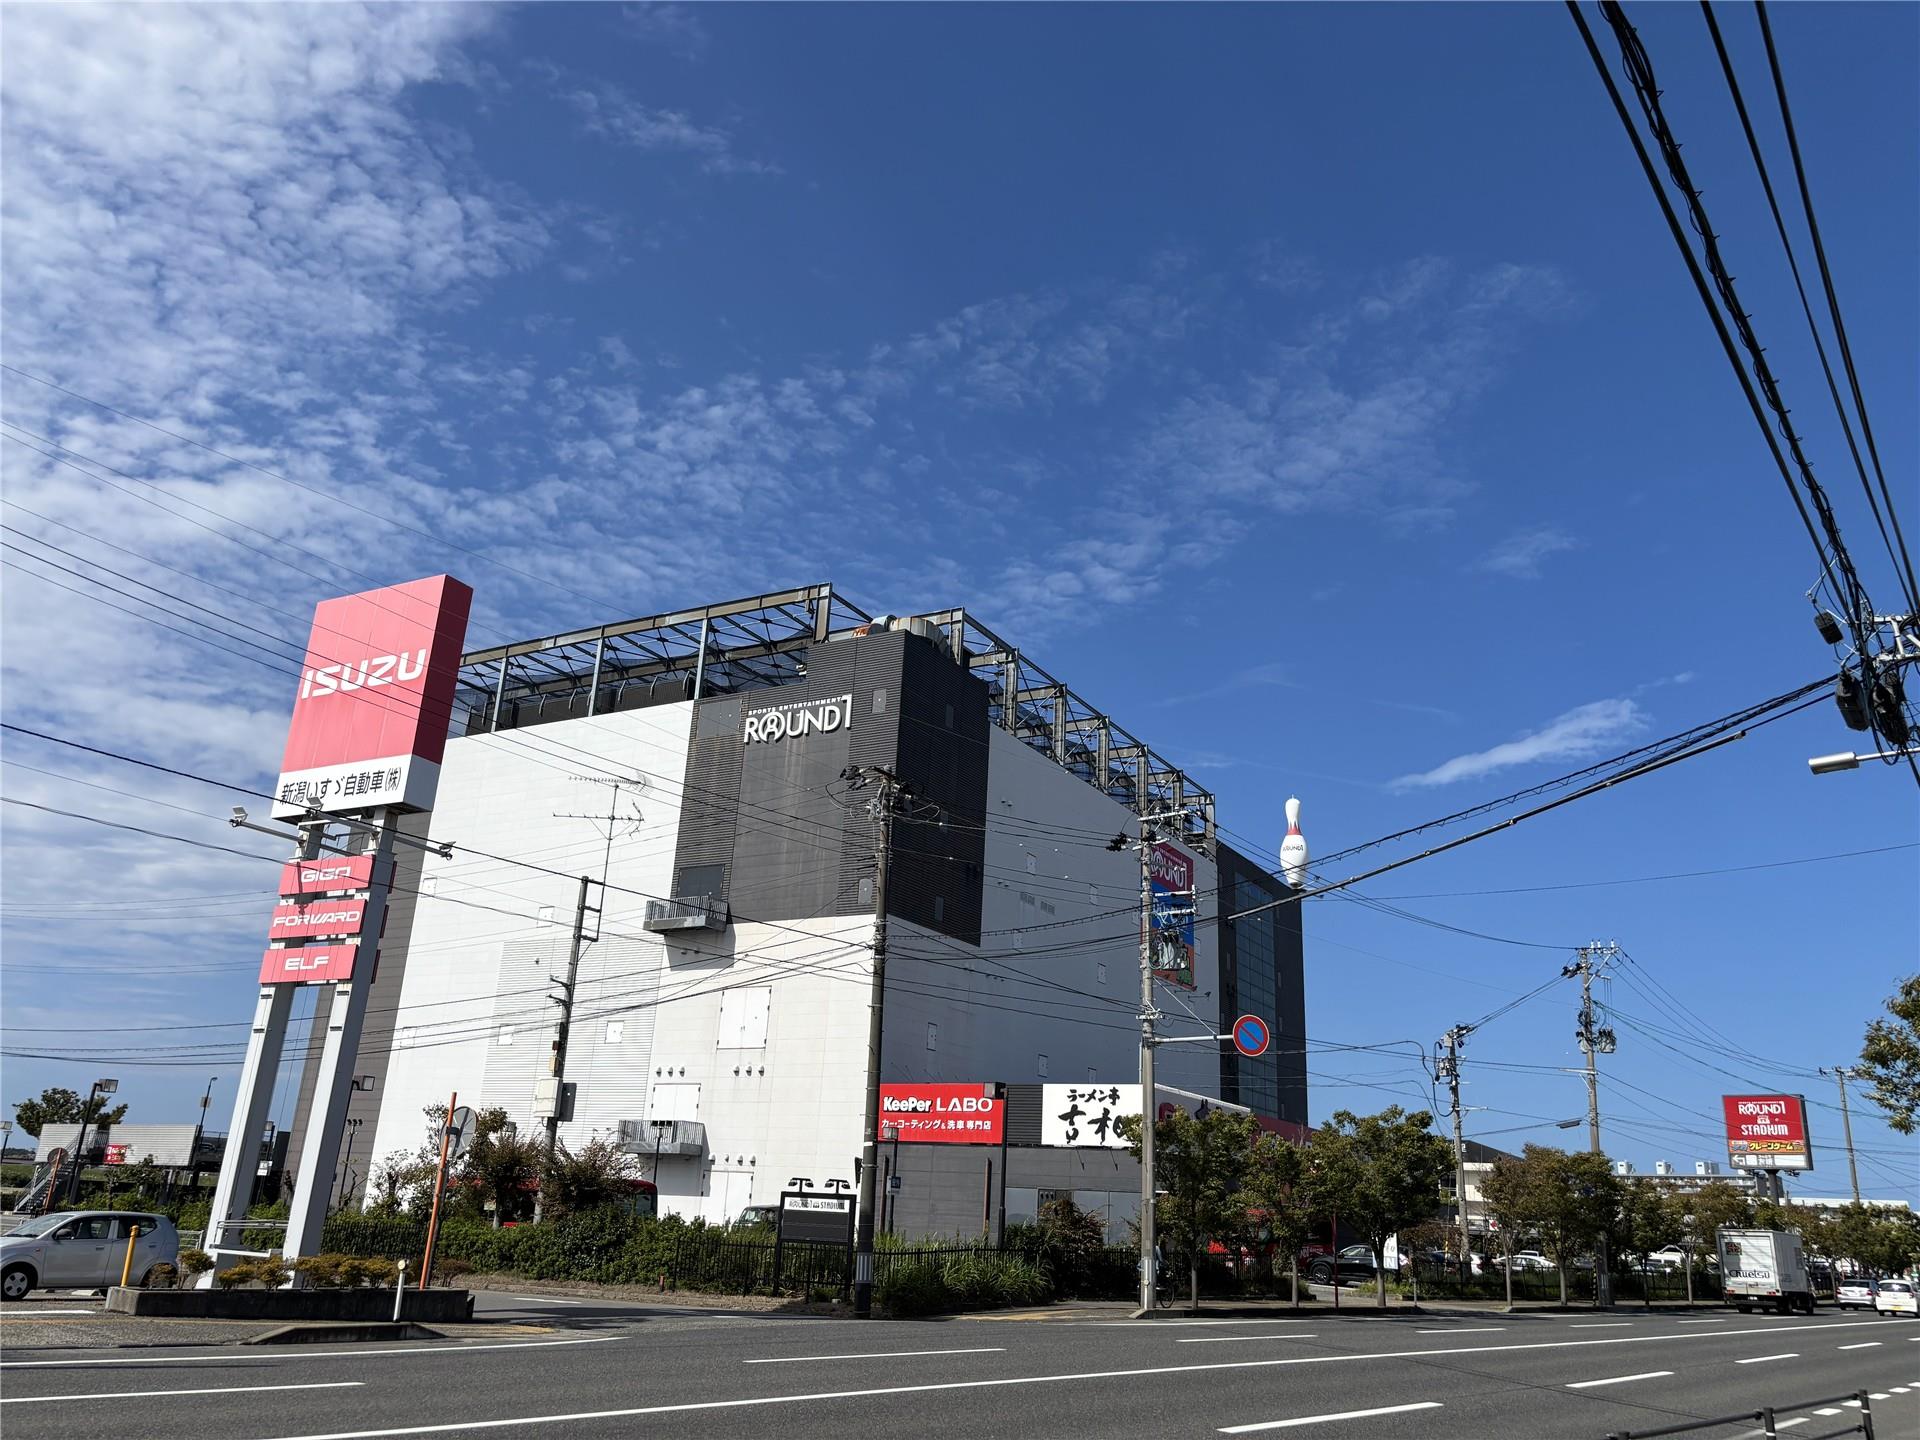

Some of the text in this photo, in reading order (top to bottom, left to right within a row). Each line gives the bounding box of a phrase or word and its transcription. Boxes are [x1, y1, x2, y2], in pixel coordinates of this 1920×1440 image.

[301, 648, 427, 699] ISUZU
[748, 696, 843, 716] SPORTS ENTERTAINMENT
[743, 692, 853, 743] ROUND1
[301, 866, 351, 883] GIGA
[272, 911, 361, 927] FORWARD
[284, 956, 330, 971] ELF
[883, 1096, 993, 1112] KeePer LABO
[1067, 1086, 1120, 1106] ラーメン亭
[1741, 1124, 1789, 1135] STADIUM
[1729, 1269, 1770, 1278] Chuetsu
